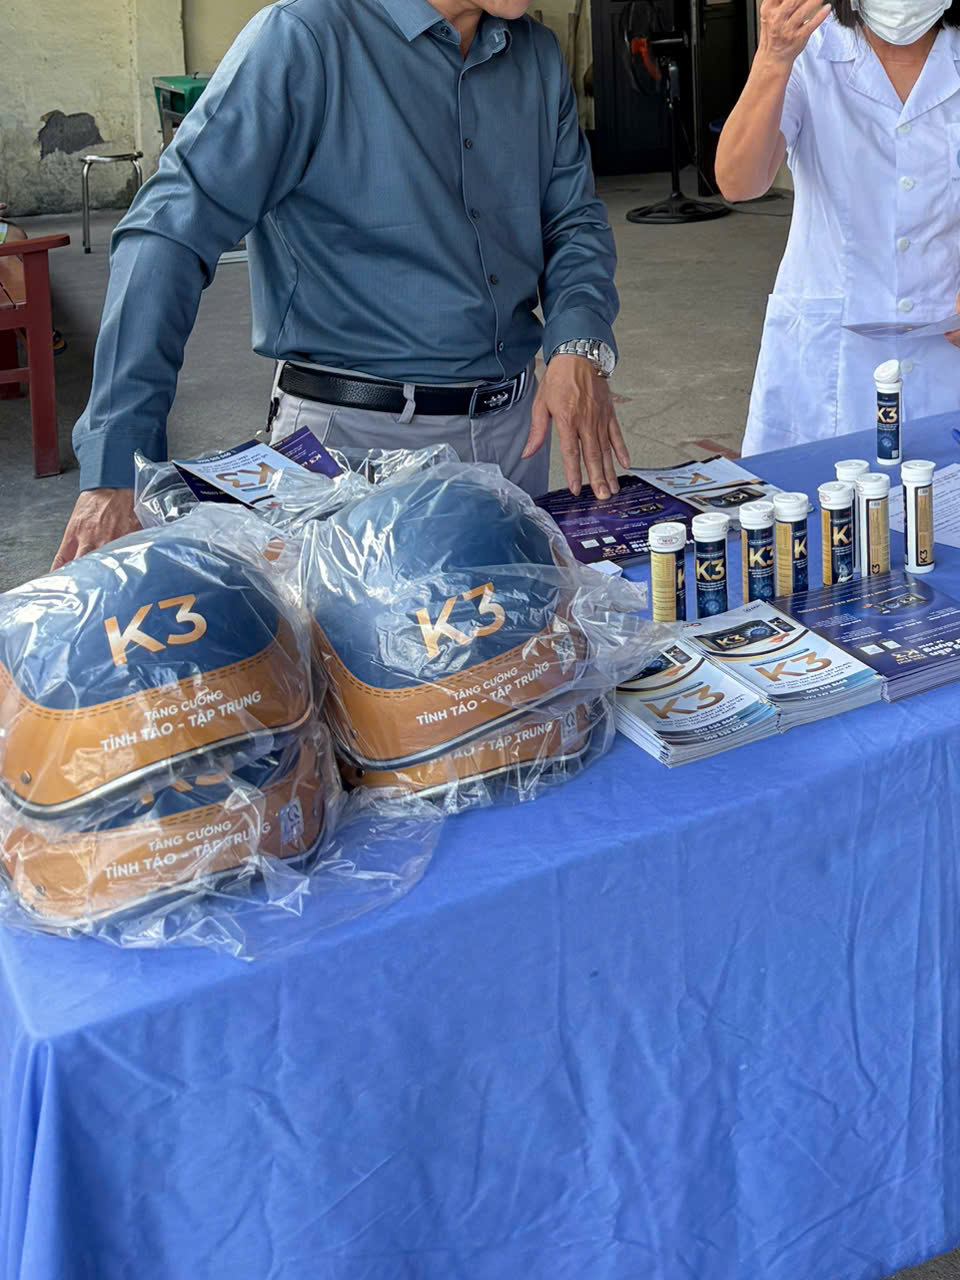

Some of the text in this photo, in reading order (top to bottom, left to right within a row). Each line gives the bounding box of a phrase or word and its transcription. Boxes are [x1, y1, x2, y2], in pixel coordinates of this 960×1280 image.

[878, 407, 897, 423] K3
[215, 461, 277, 489] K3
[696, 559, 725, 581] K3
[919, 549, 928, 563] K3
[104, 593, 207, 667] K3
[416, 582, 505, 660] K3
[715, 634, 745, 647] K3
[754, 651, 832, 684] K3
[416, 709, 448, 726] TỈNH
[450, 698, 478, 717] TÁO
[490, 683, 512, 702] TẬP
[514, 661, 550, 689] TRUNG
[453, 667, 518, 701] TĂNG CƯỜNG
[144, 704, 178, 722] TĂNG
[643, 684, 725, 720] K3
[100, 729, 137, 752] TỈNH
[188, 708, 215, 728] TẬP
[218, 690, 262, 716] TRUNG
[514, 721, 553, 743] TRUNG
[149, 821, 232, 852] TĂNG CƯỜNG
[104, 859, 139, 880] TỈNH
